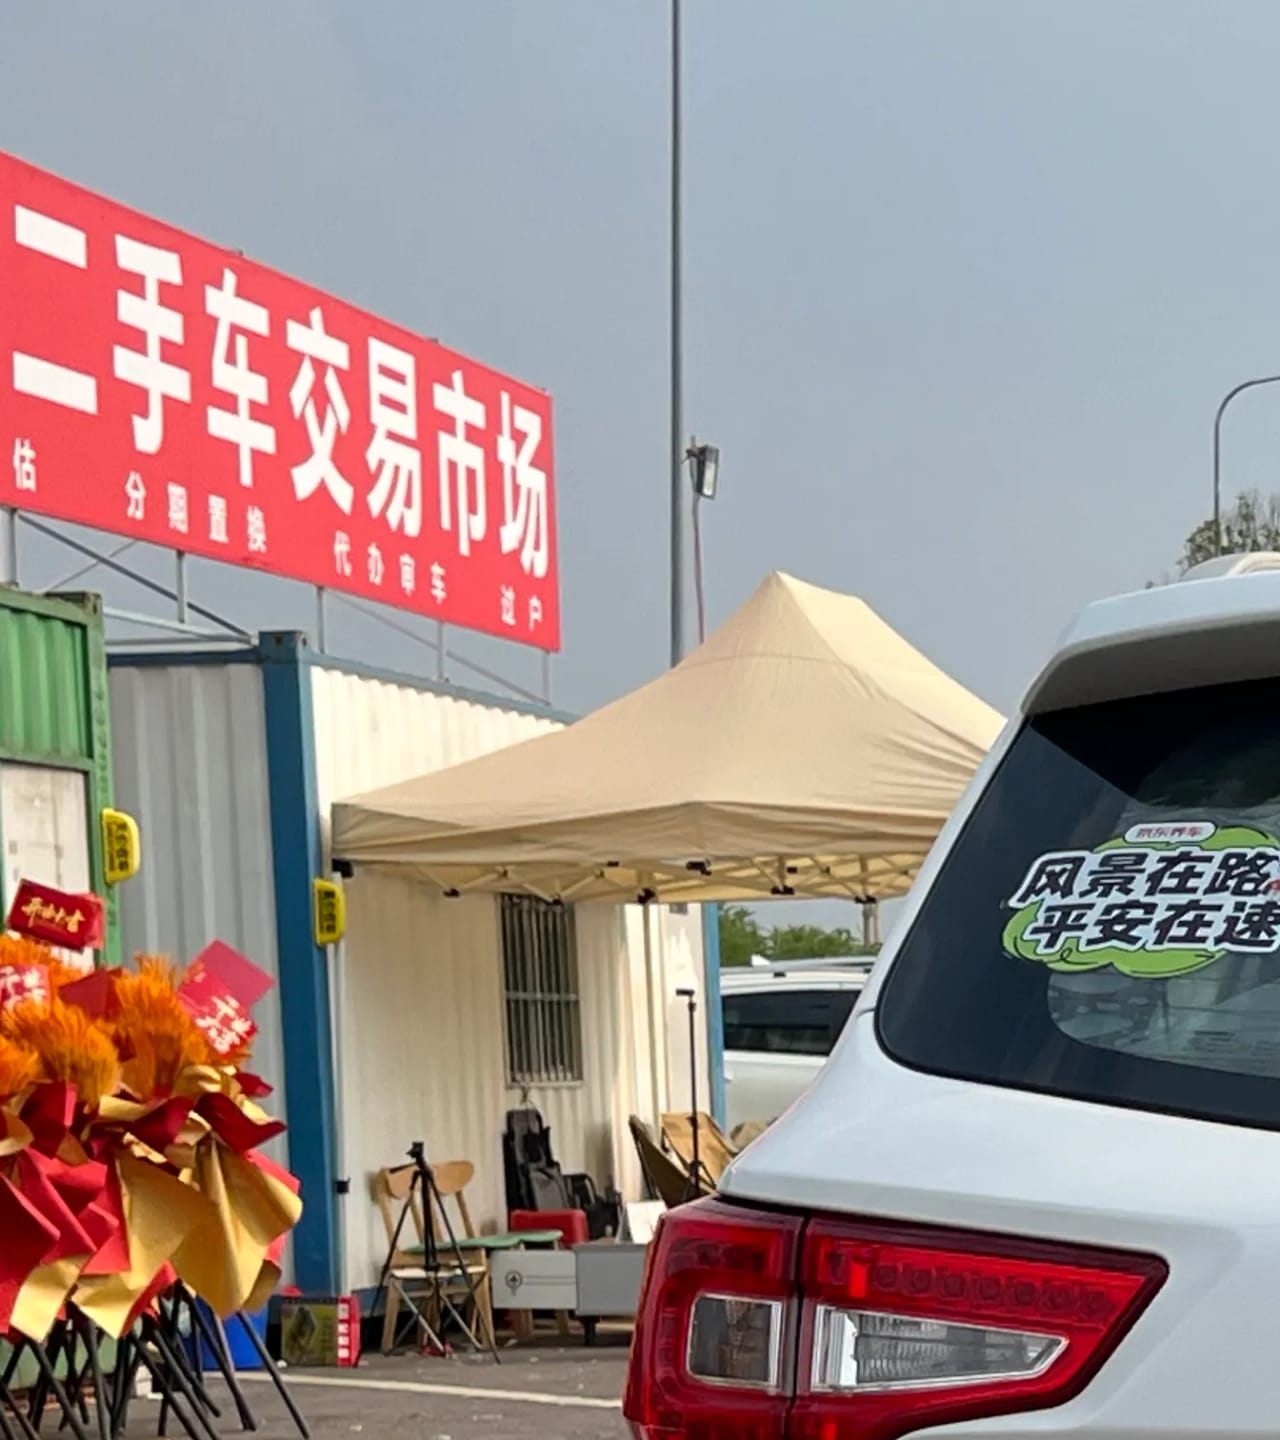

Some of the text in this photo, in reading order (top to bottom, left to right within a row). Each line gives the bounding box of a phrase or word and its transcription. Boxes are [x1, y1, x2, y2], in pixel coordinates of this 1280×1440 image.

[12, 205, 548, 579] 二手车交易市场
[13, 437, 37, 492] 估
[1021, 850, 1276, 900] 风景在路
